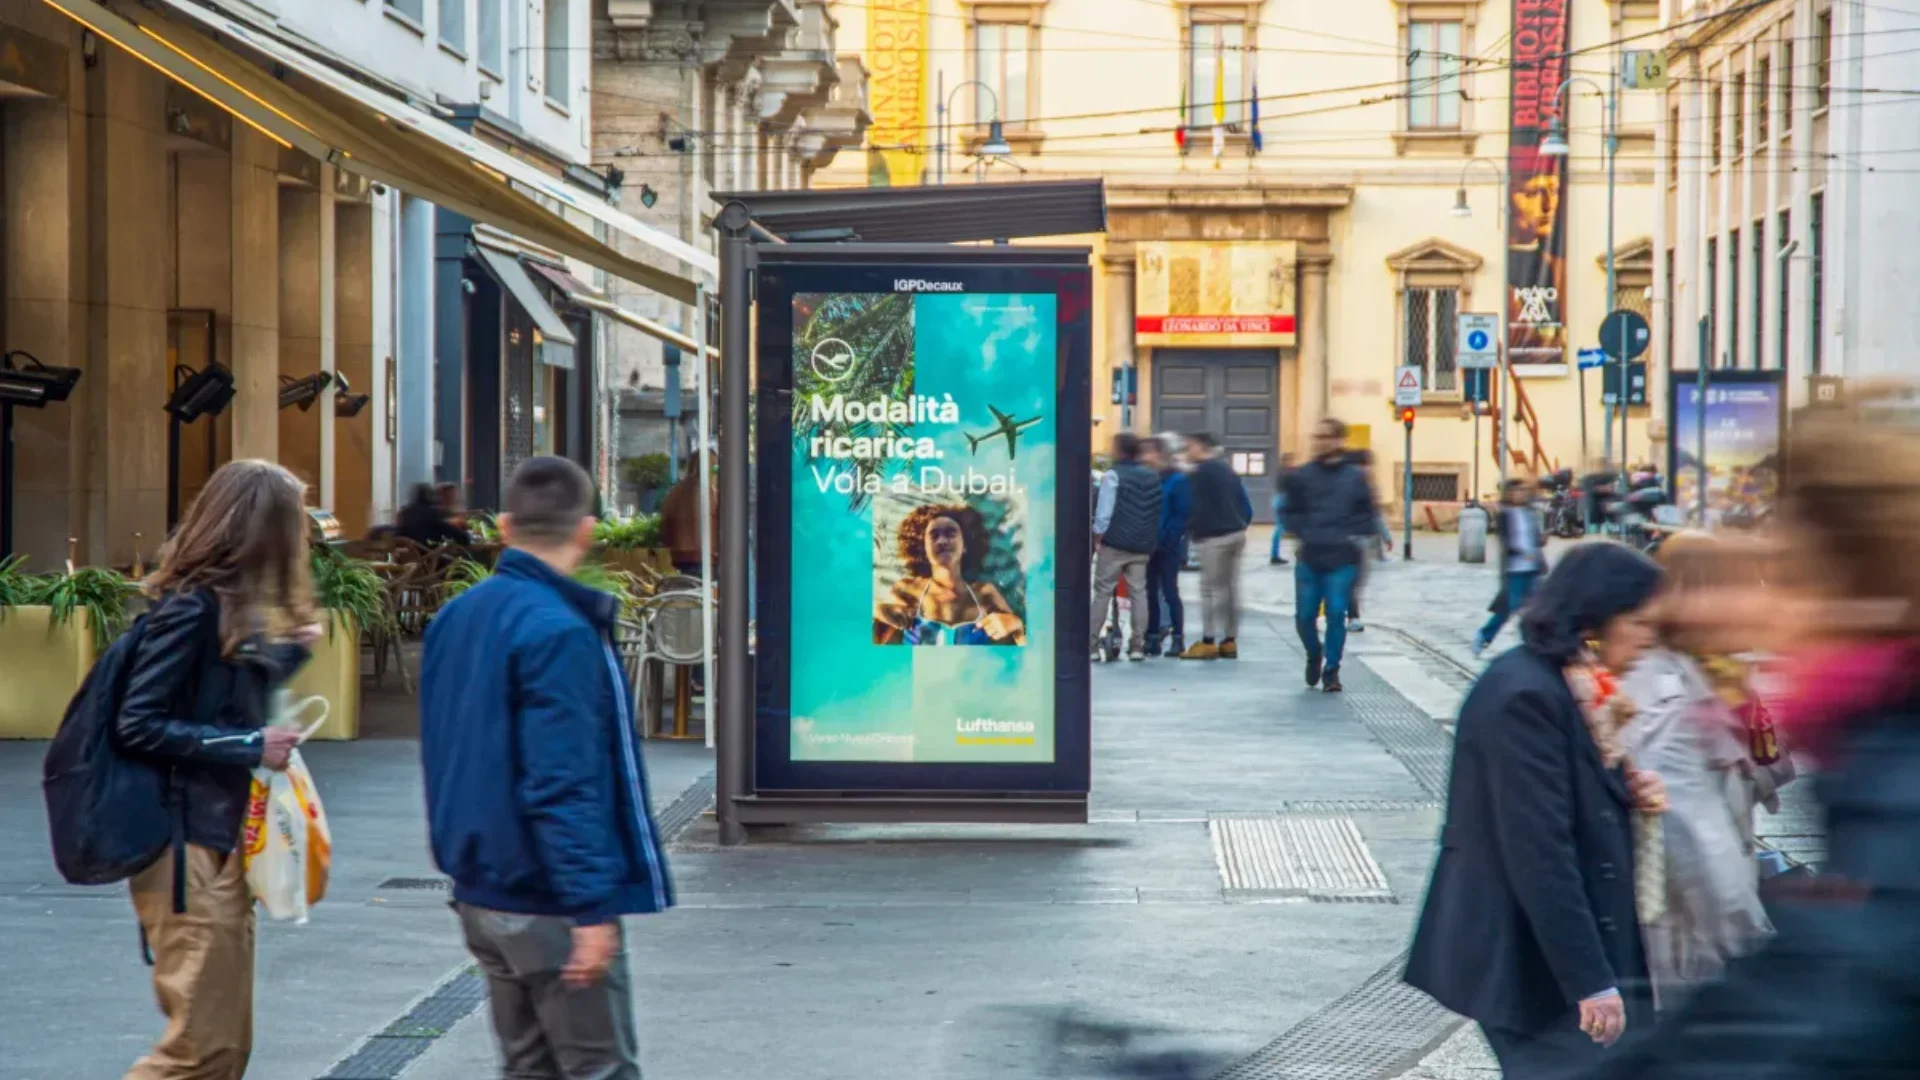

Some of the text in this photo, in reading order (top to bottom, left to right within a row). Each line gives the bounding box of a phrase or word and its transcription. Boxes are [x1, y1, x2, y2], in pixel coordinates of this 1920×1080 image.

[893, 279, 963, 292] IGPDecaux
[1162, 320, 1220, 333] LEONARDO
[810, 393, 960, 424] Modalità
[810, 429, 944, 459] ricarica.
[811, 465, 1024, 494] Vola a Dubai.
[956, 717, 1034, 733] Lufthansa
